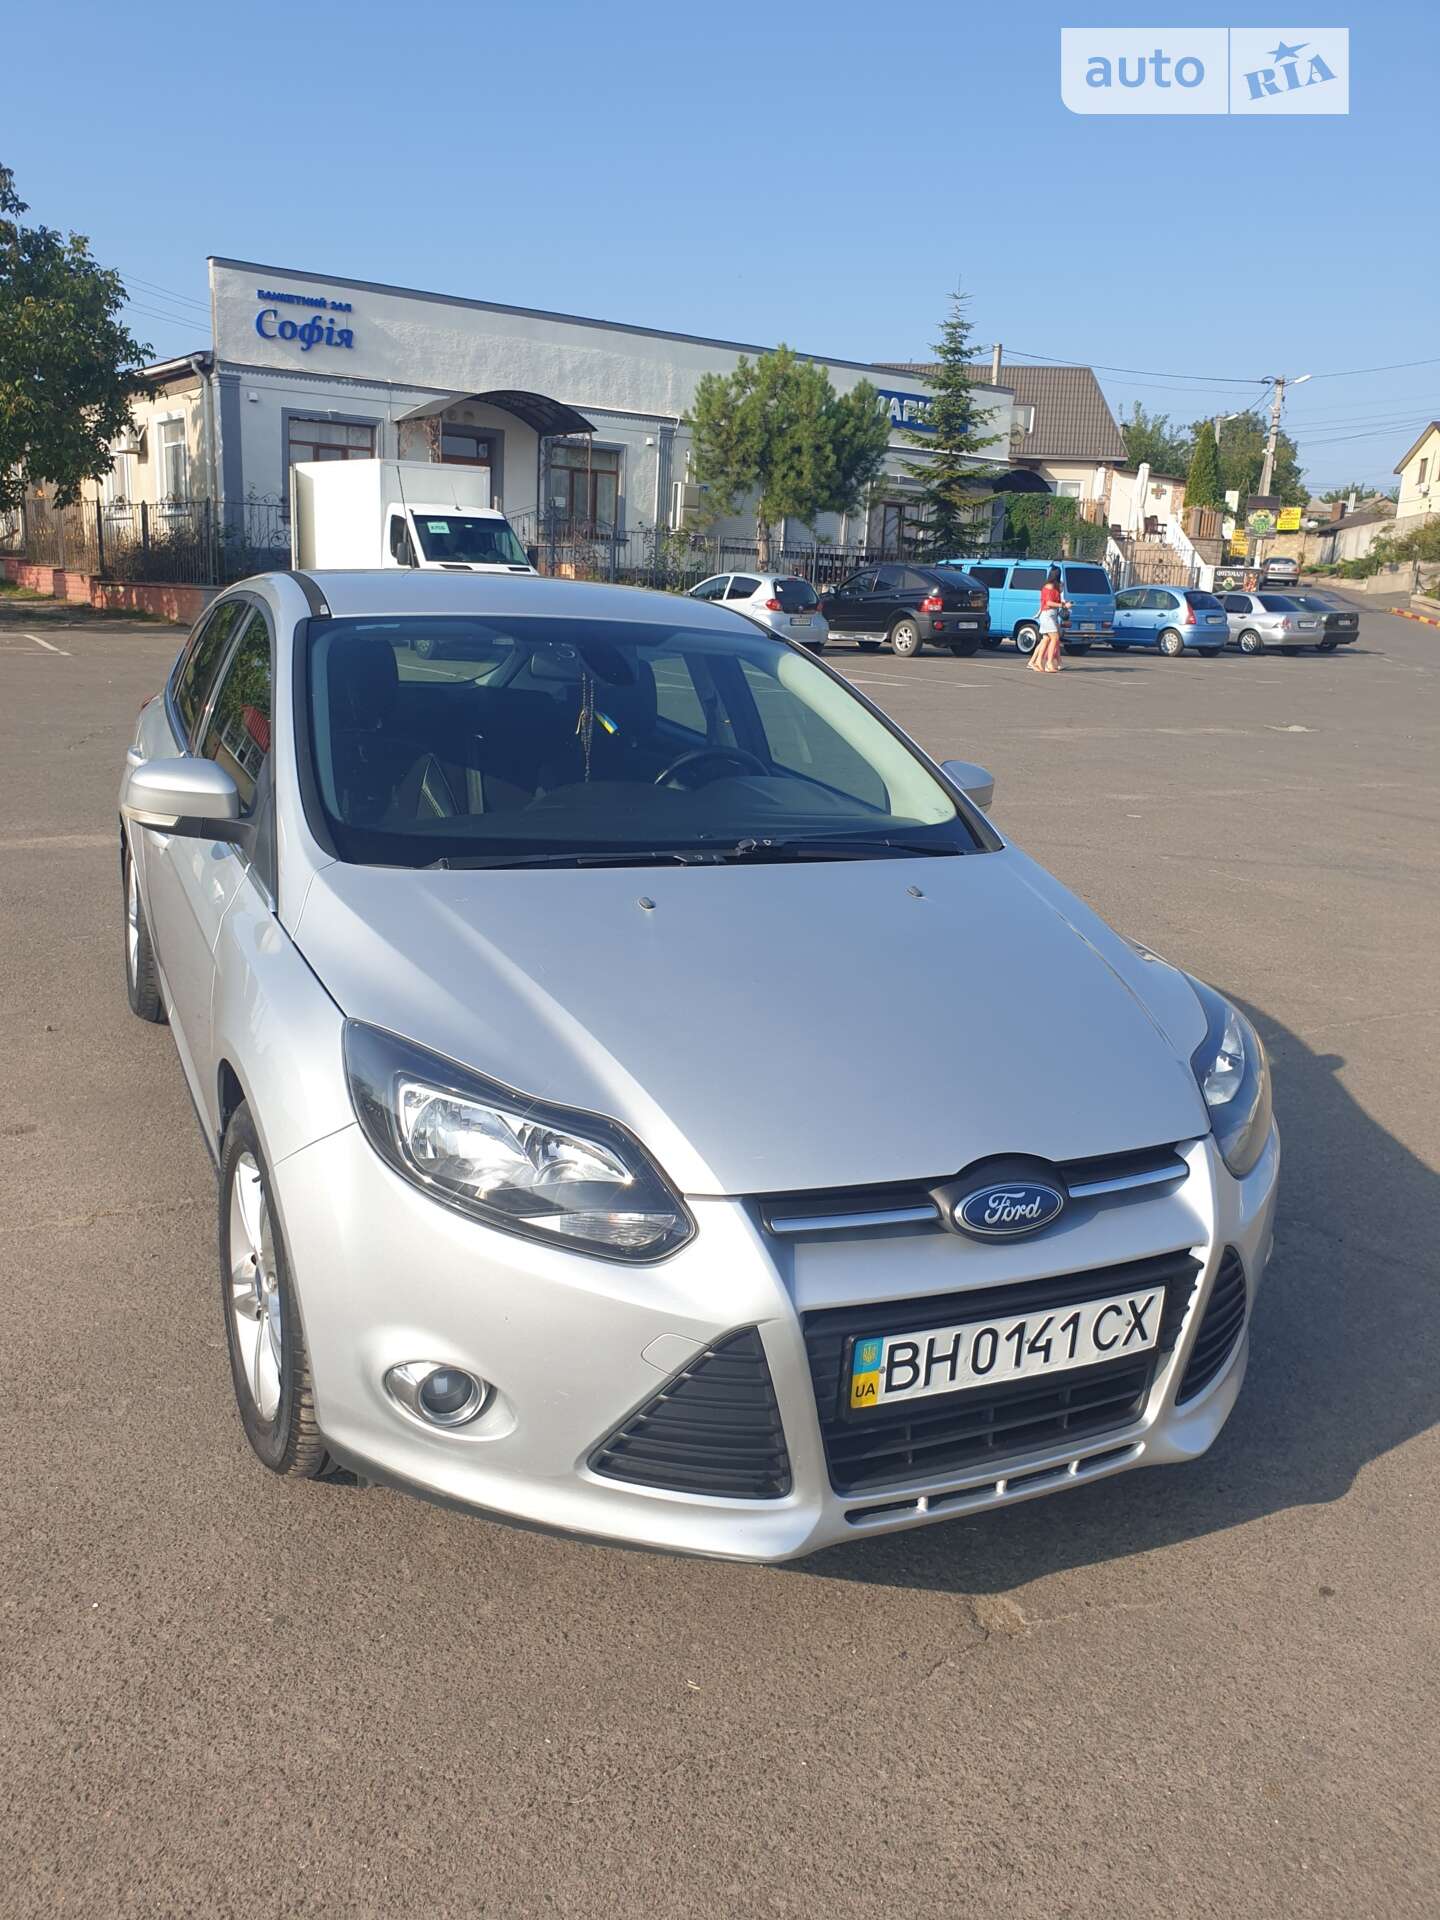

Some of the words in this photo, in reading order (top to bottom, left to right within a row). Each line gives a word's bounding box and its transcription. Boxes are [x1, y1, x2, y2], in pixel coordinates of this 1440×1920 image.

[255, 308, 354, 352] Софія
[984, 1192, 1041, 1225] Ford
[855, 1383, 876, 1399] UA
